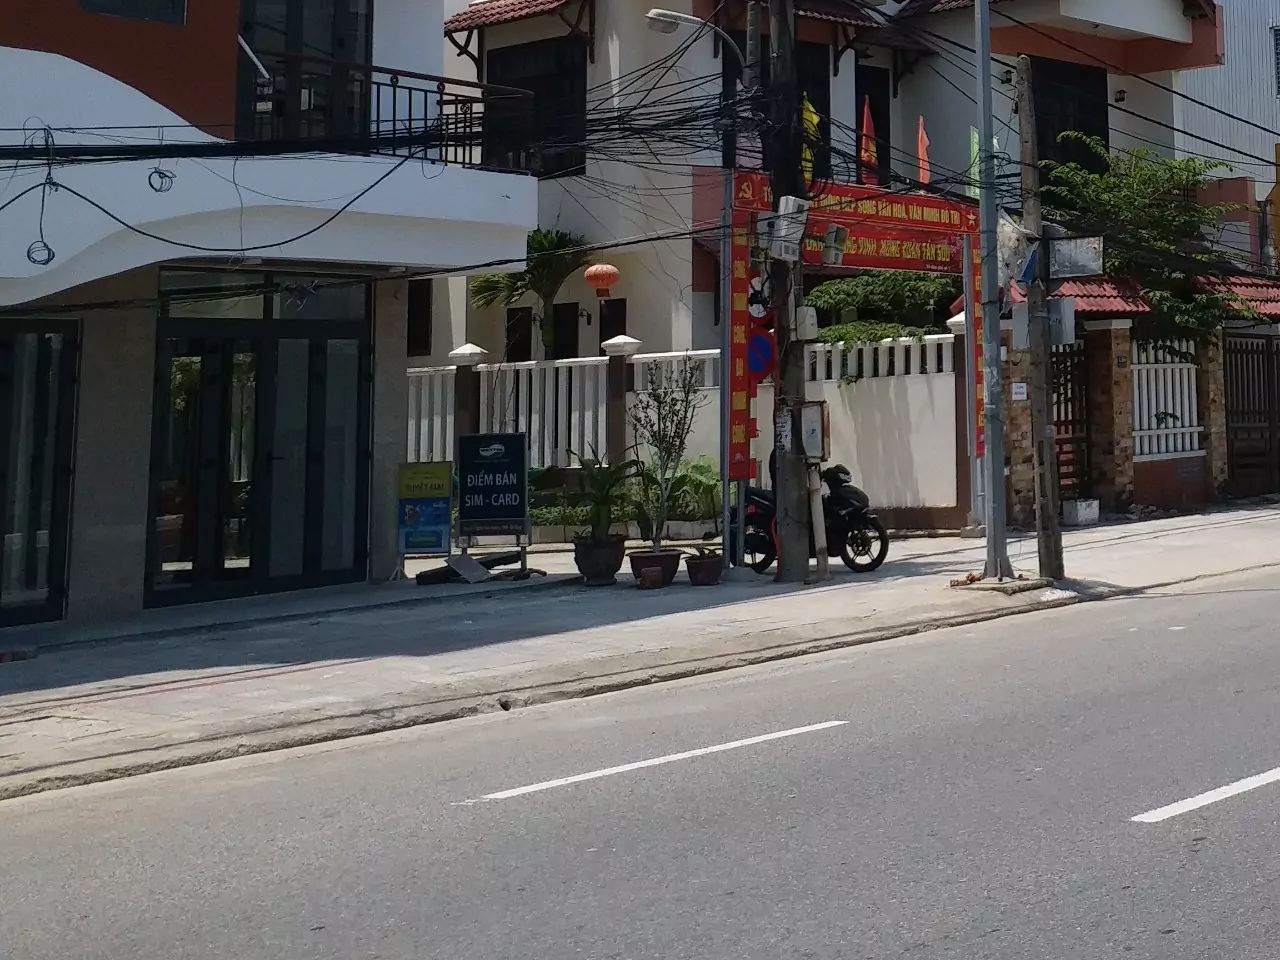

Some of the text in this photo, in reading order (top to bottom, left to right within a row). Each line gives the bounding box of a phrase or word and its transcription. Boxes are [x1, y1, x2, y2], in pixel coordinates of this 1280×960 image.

[467, 469, 517, 486] ĐIỂM BÁN
[465, 494, 483, 507] SIM
[491, 493, 520, 506] CARD
